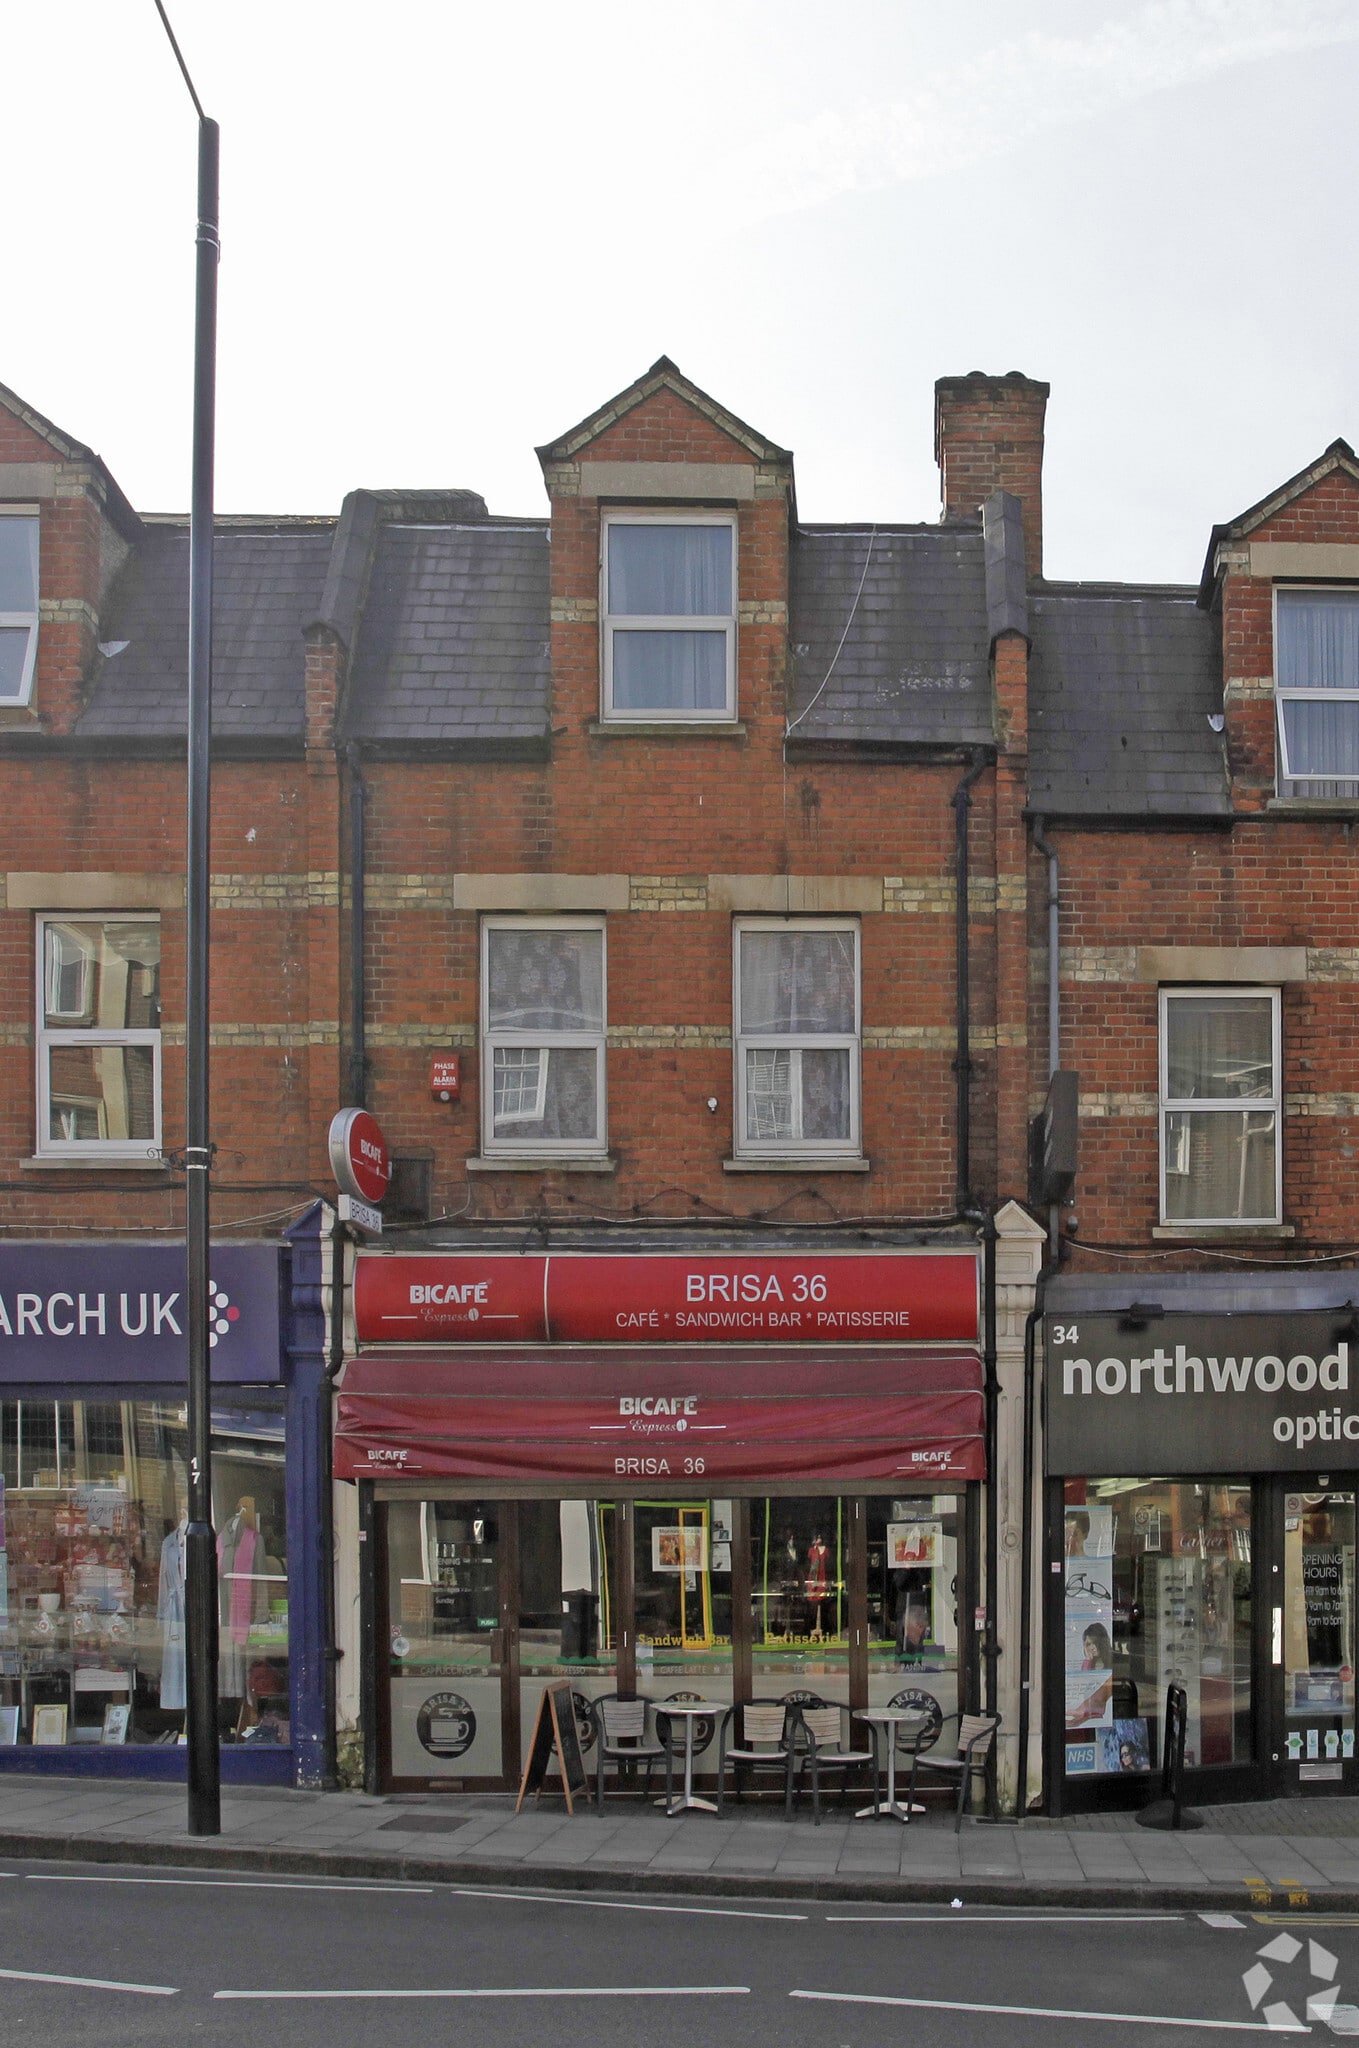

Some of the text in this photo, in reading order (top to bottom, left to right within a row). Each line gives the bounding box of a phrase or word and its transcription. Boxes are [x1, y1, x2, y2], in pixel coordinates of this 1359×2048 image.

[434, 1062, 455, 1070] PHASE
[351, 1202, 371, 1225] BRISA
[410, 1282, 488, 1304] BICAFÉ
[686, 1274, 827, 1302] BRISA 36
[0, 1292, 182, 1336] ARCH UK
[616, 1309, 909, 1327] CAFÉ SANDWICH BAR PATISSERIE
[1053, 1325, 1079, 1344] 34
[1063, 1342, 1349, 1395] northwood
[1273, 1407, 1359, 1449] optic
[615, 1457, 705, 1475] BRISA 36
[1303, 1567, 1338, 1579] HOURS
[423, 1695, 456, 1714] BRISA
[1067, 1749, 1094, 1764] NHS
